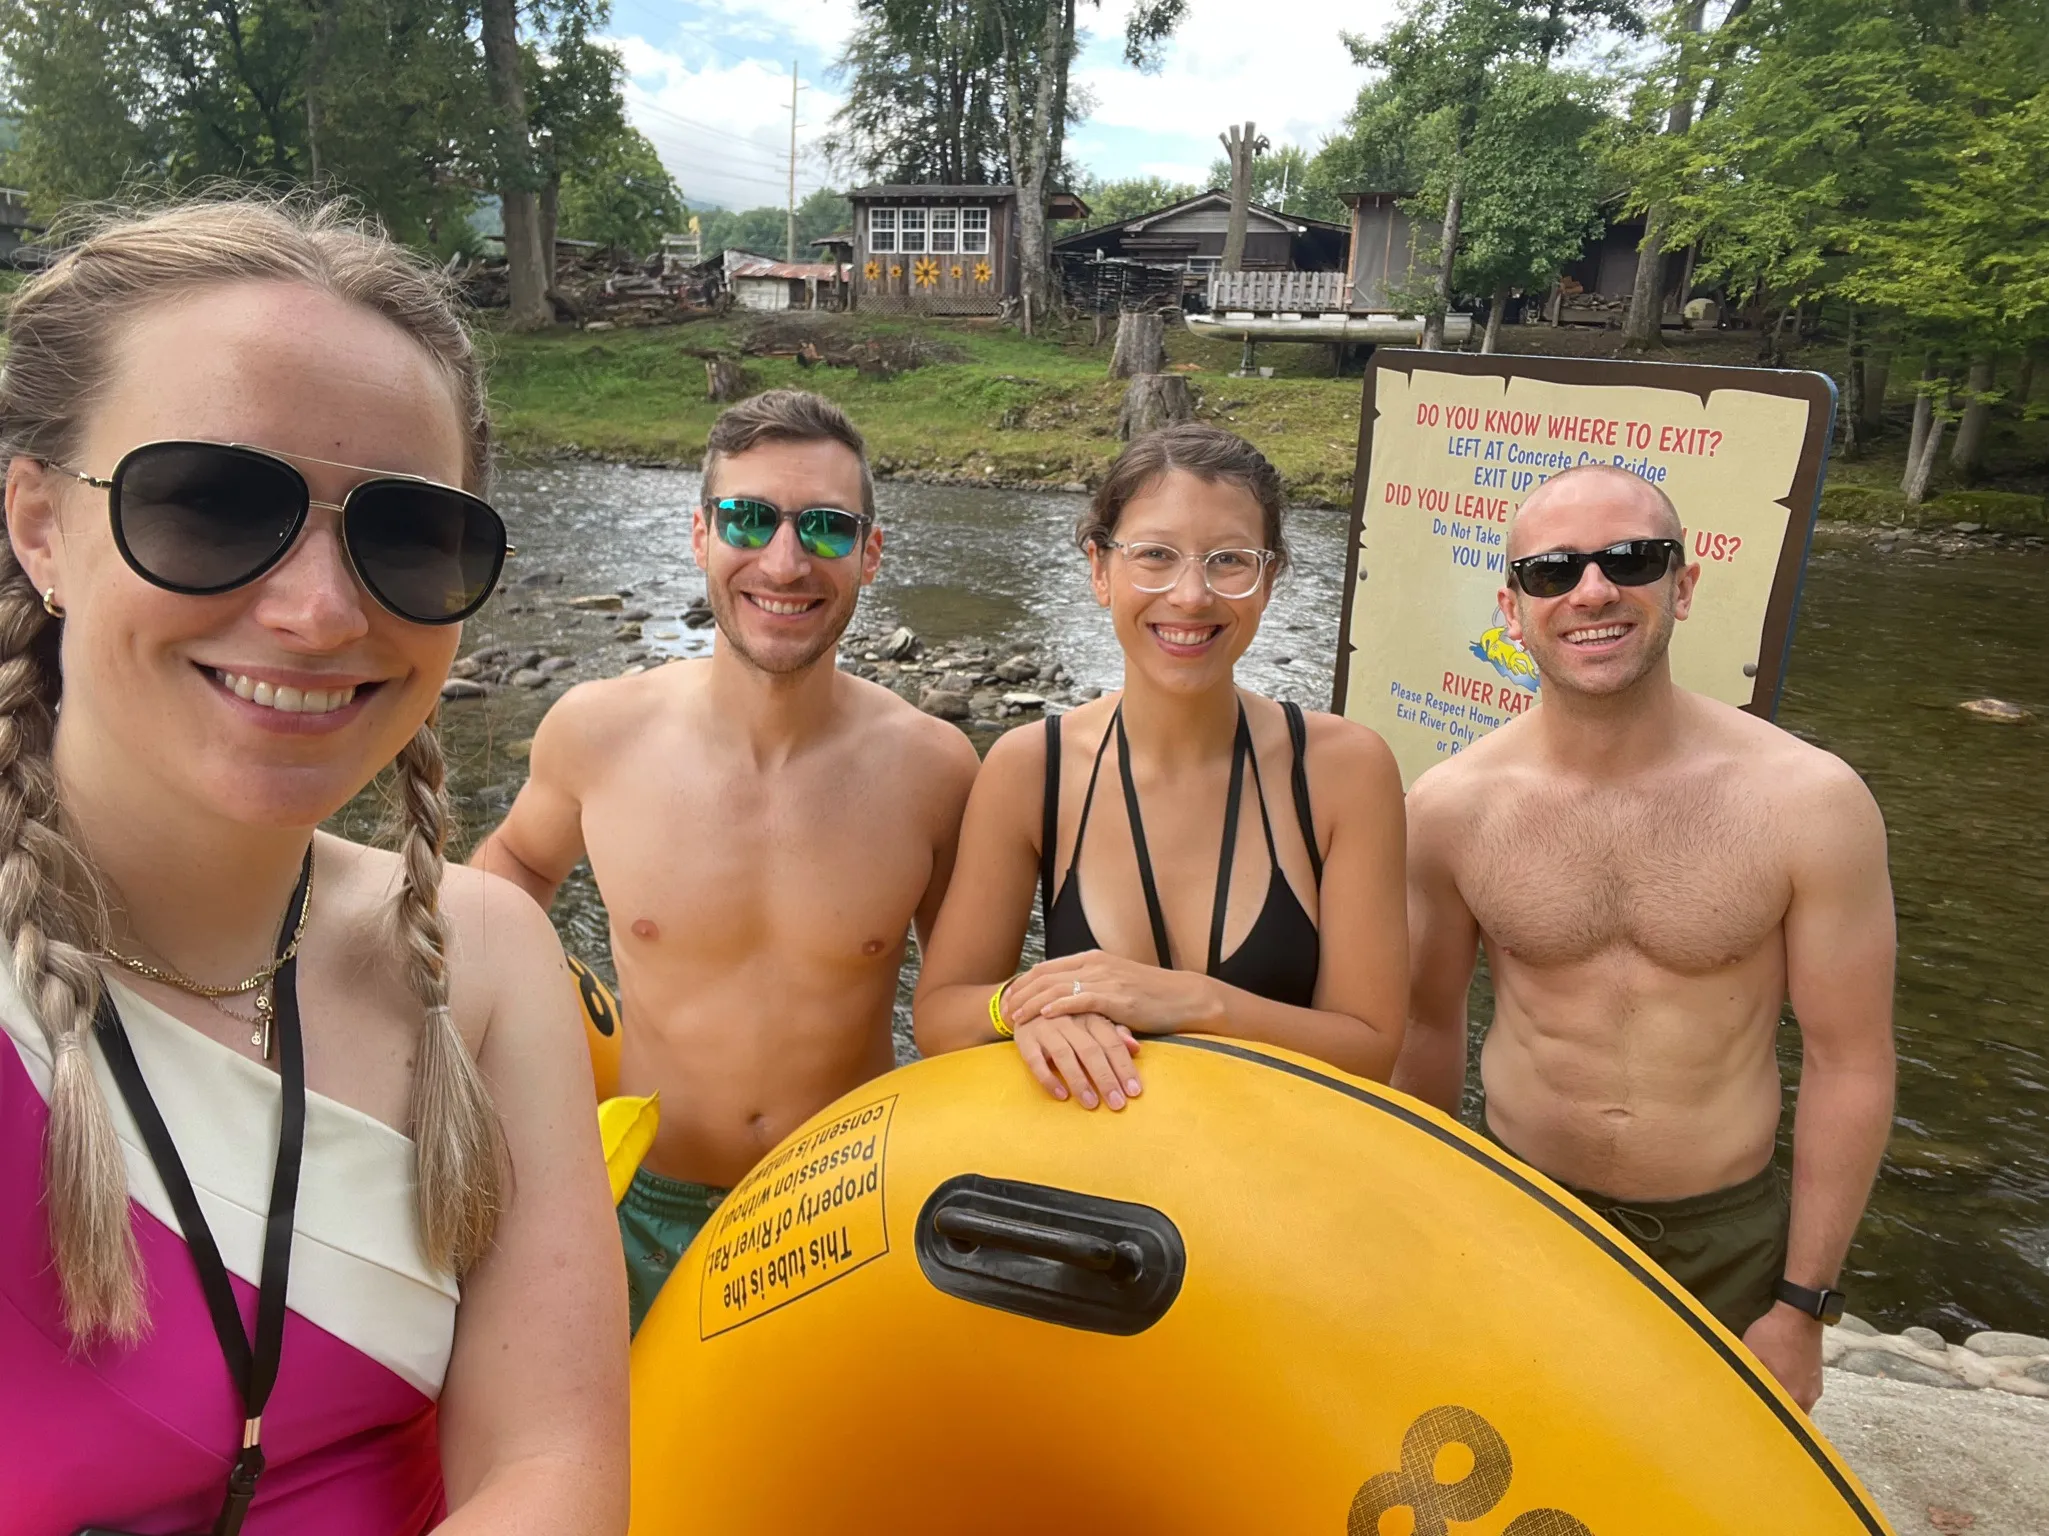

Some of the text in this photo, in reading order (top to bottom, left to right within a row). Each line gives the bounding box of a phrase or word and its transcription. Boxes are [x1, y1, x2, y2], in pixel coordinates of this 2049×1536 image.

[1417, 403, 1723, 457] DO YOU KNOW WHERE TO EXIT?
[1448, 436, 1482, 458] LEFT
[1484, 440, 1504, 461] AT
[1507, 443, 1572, 469] Concrete
[1474, 466, 1507, 489] EXIT
[1511, 471, 1533, 492] UP
[1385, 482, 1742, 563] DID YOU LEAVE US?
[1432, 518, 1501, 546] Do Not Take
[1452, 545, 1481, 568] YOU
[1390, 682, 1500, 729] Please Respect Home
[1442, 671, 1534, 714] RIVER RAT
[1397, 703, 1475, 745] Exit River Only
[1436, 740, 1448, 753] or
[797, 1141, 812, 1159] is
[811, 1105, 884, 1154] consent
[719, 1135, 876, 1236] Possession without
[796, 1163, 878, 1227] property
[733, 1217, 773, 1259] River
[776, 1208, 793, 1244] of
[723, 1226, 852, 1311] This tube is the
